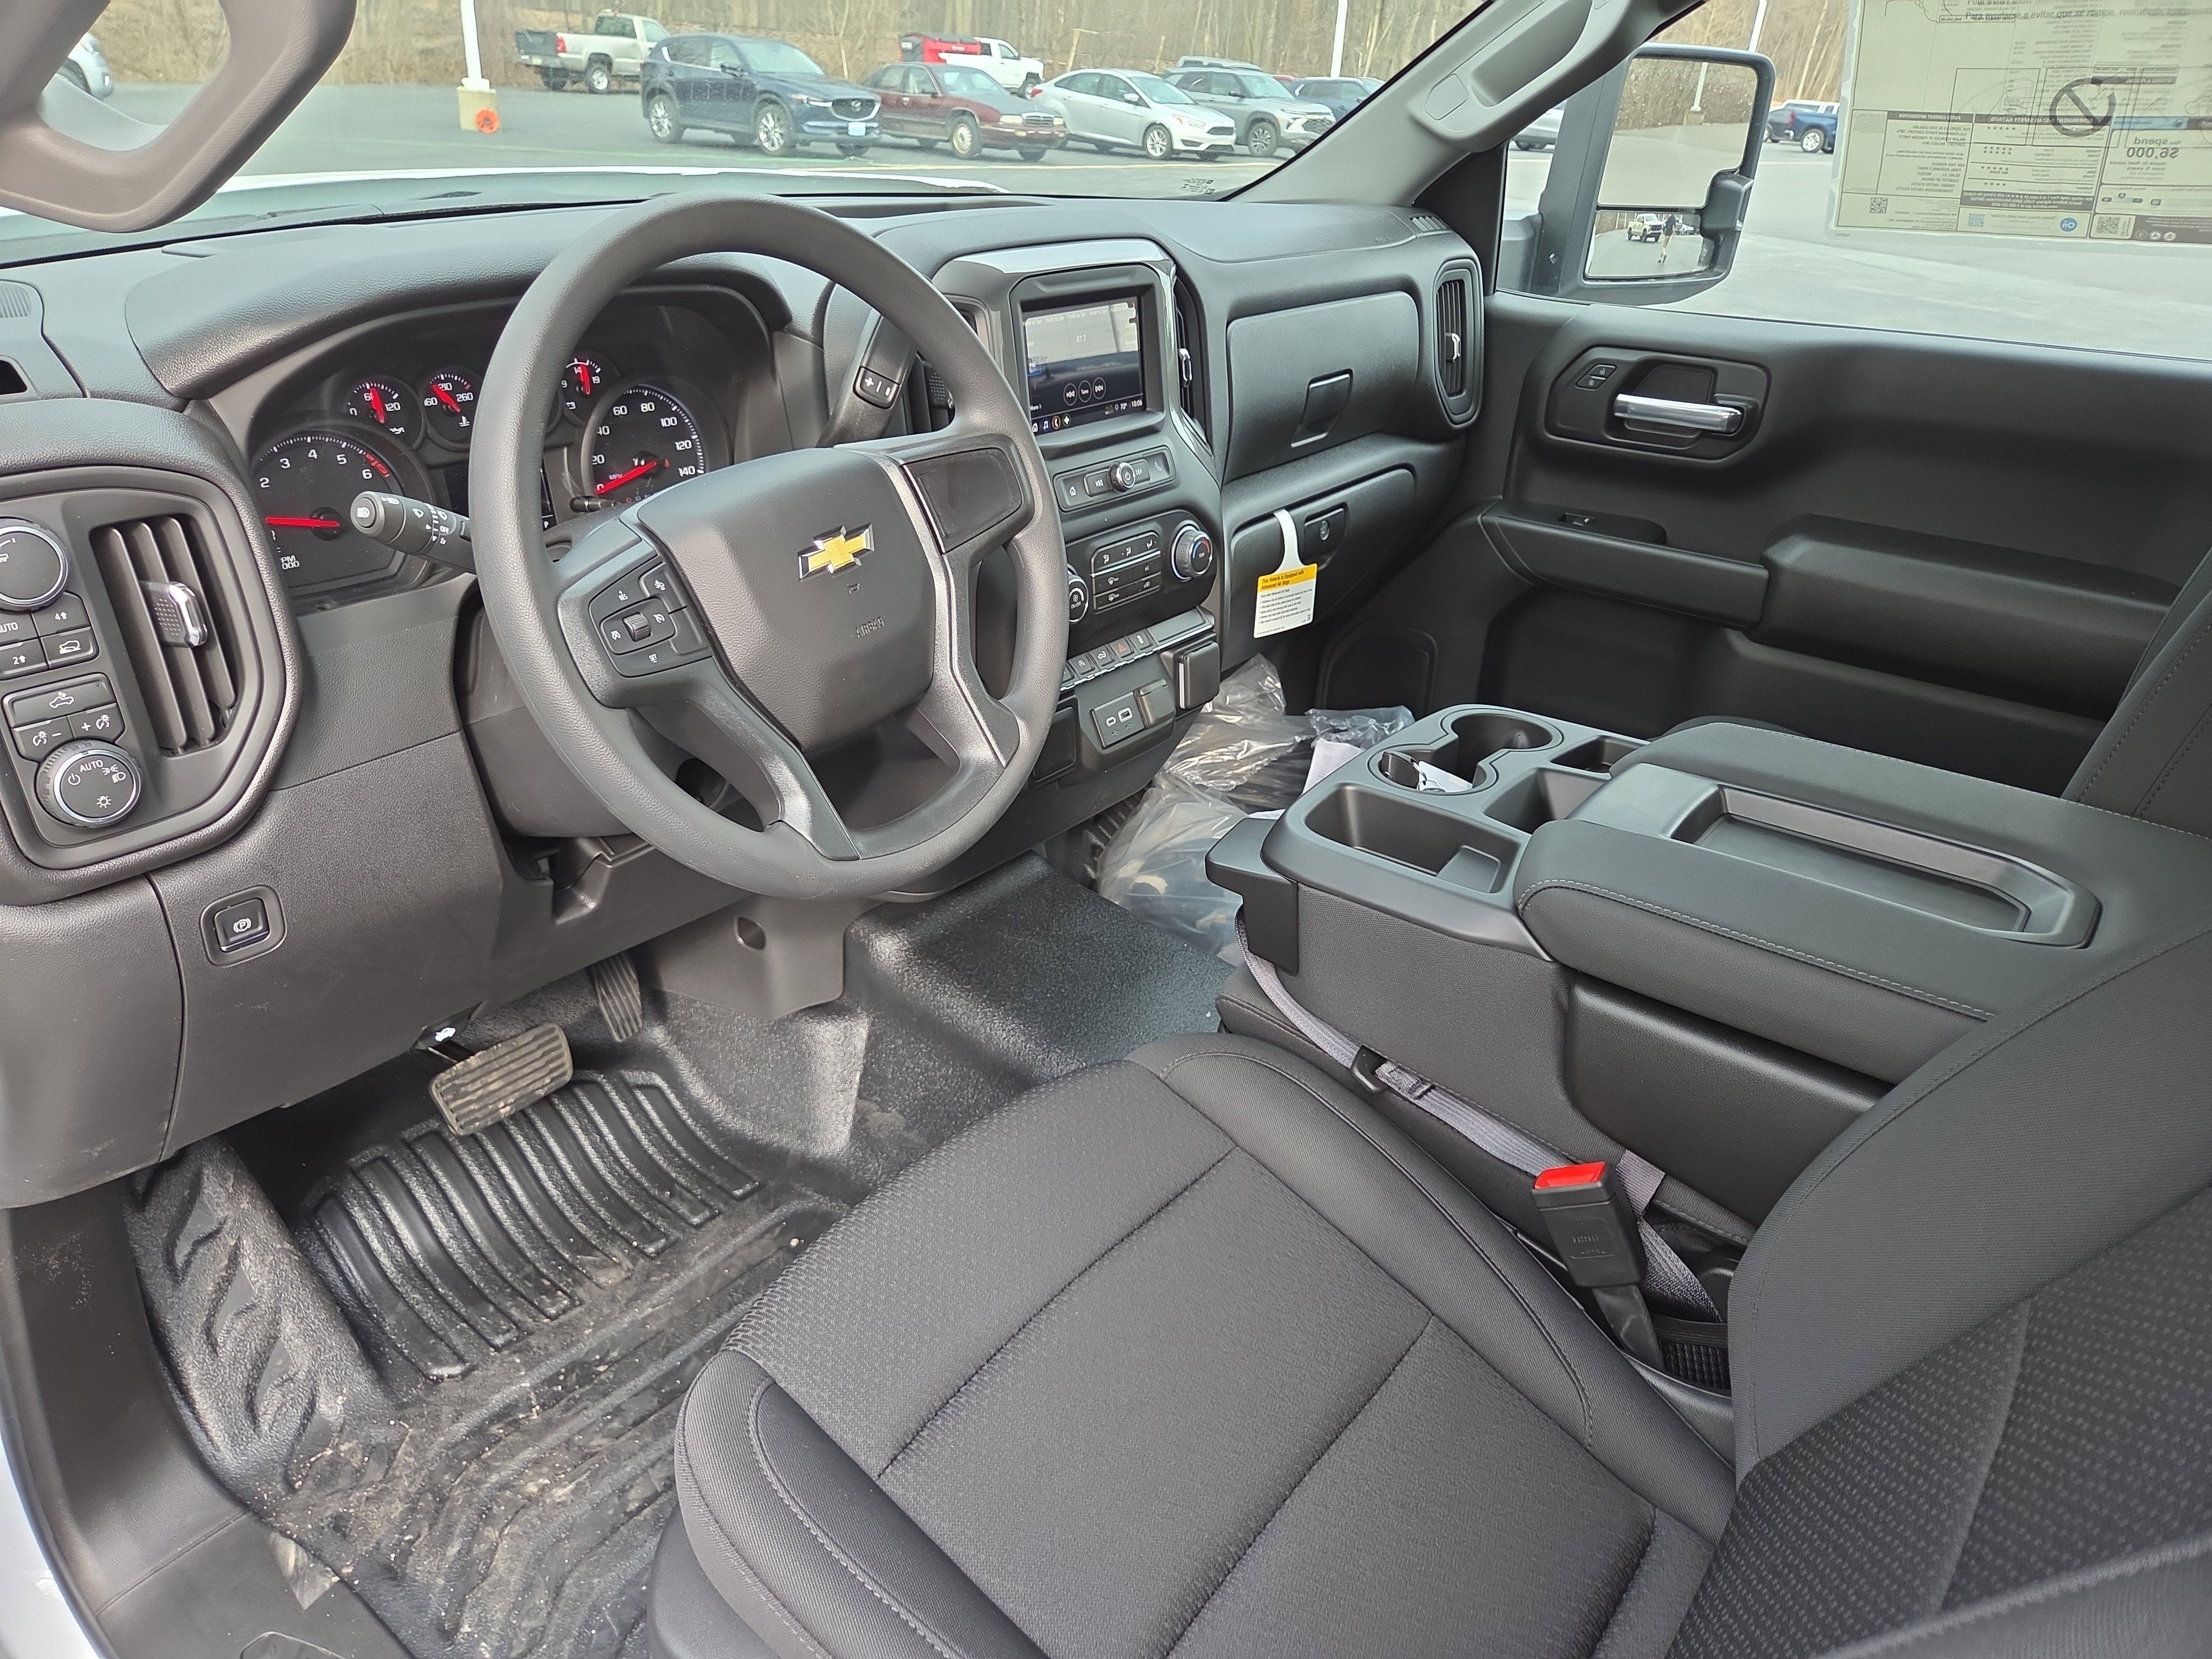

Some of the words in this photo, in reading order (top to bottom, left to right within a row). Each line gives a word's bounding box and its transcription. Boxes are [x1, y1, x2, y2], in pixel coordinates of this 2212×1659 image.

[2031, 10, 2055, 18] evitar
[2057, 10, 2073, 19] que
[438, 382, 453, 391] 210
[455, 393, 473, 402] 260
[385, 402, 401, 411] 120
[640, 402, 655, 413] 80
[1131, 399, 1143, 408] 10:06
[613, 406, 628, 416] 60
[660, 416, 678, 427] 100
[674, 440, 692, 451] 120
[308, 449, 318, 460] 4
[336, 454, 347, 465] 5
[280, 458, 291, 469] 3
[362, 469, 372, 479] 6
[678, 466, 696, 477] 140
[259, 477, 271, 488] 2
[440, 525, 449, 534] OFF
[280, 555, 297, 564] PM
[281, 561, 300, 570] 000
[55, 613, 61, 621] 4
[12, 656, 20, 665] 2
[649, 653, 658, 663] SET
[79, 758, 104, 773] AUTO
